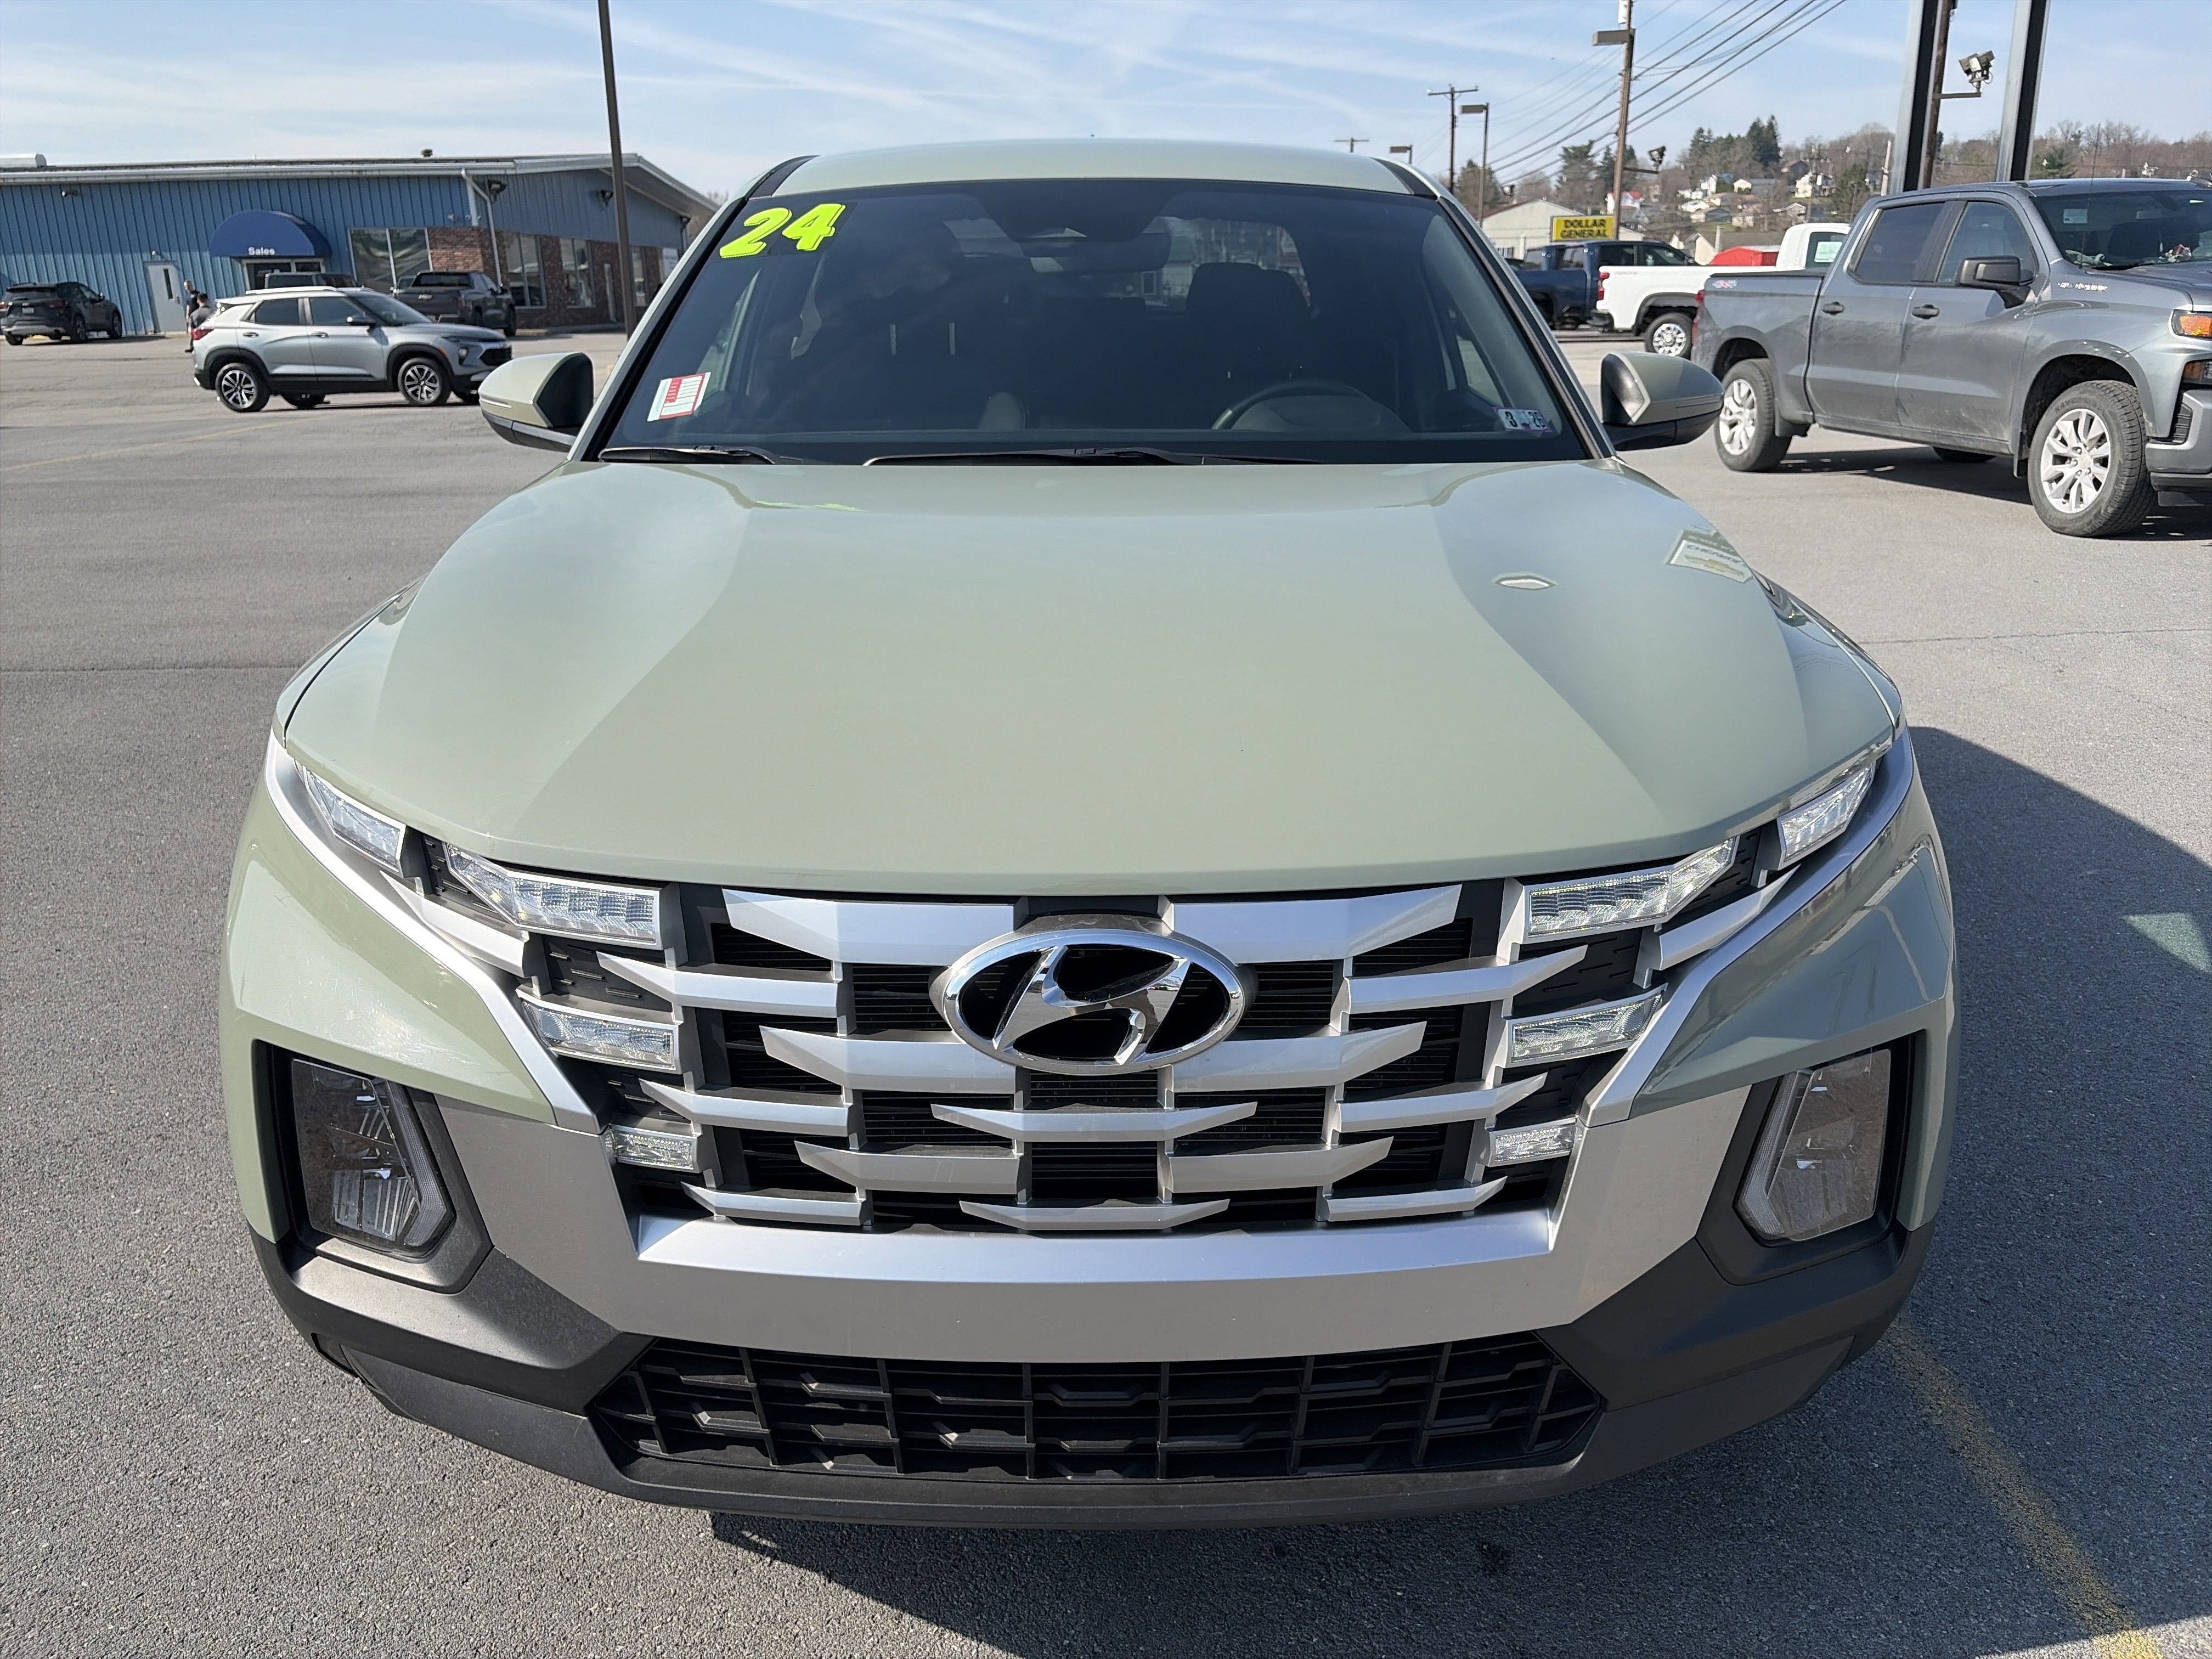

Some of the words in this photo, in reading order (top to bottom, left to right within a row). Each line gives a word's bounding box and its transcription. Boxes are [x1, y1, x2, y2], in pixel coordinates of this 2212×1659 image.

[1564, 219, 1606, 228] DOLLAR
[719, 204, 846, 258] 24
[1560, 229, 1609, 239] GENERAL
[248, 247, 275, 256] Sales
